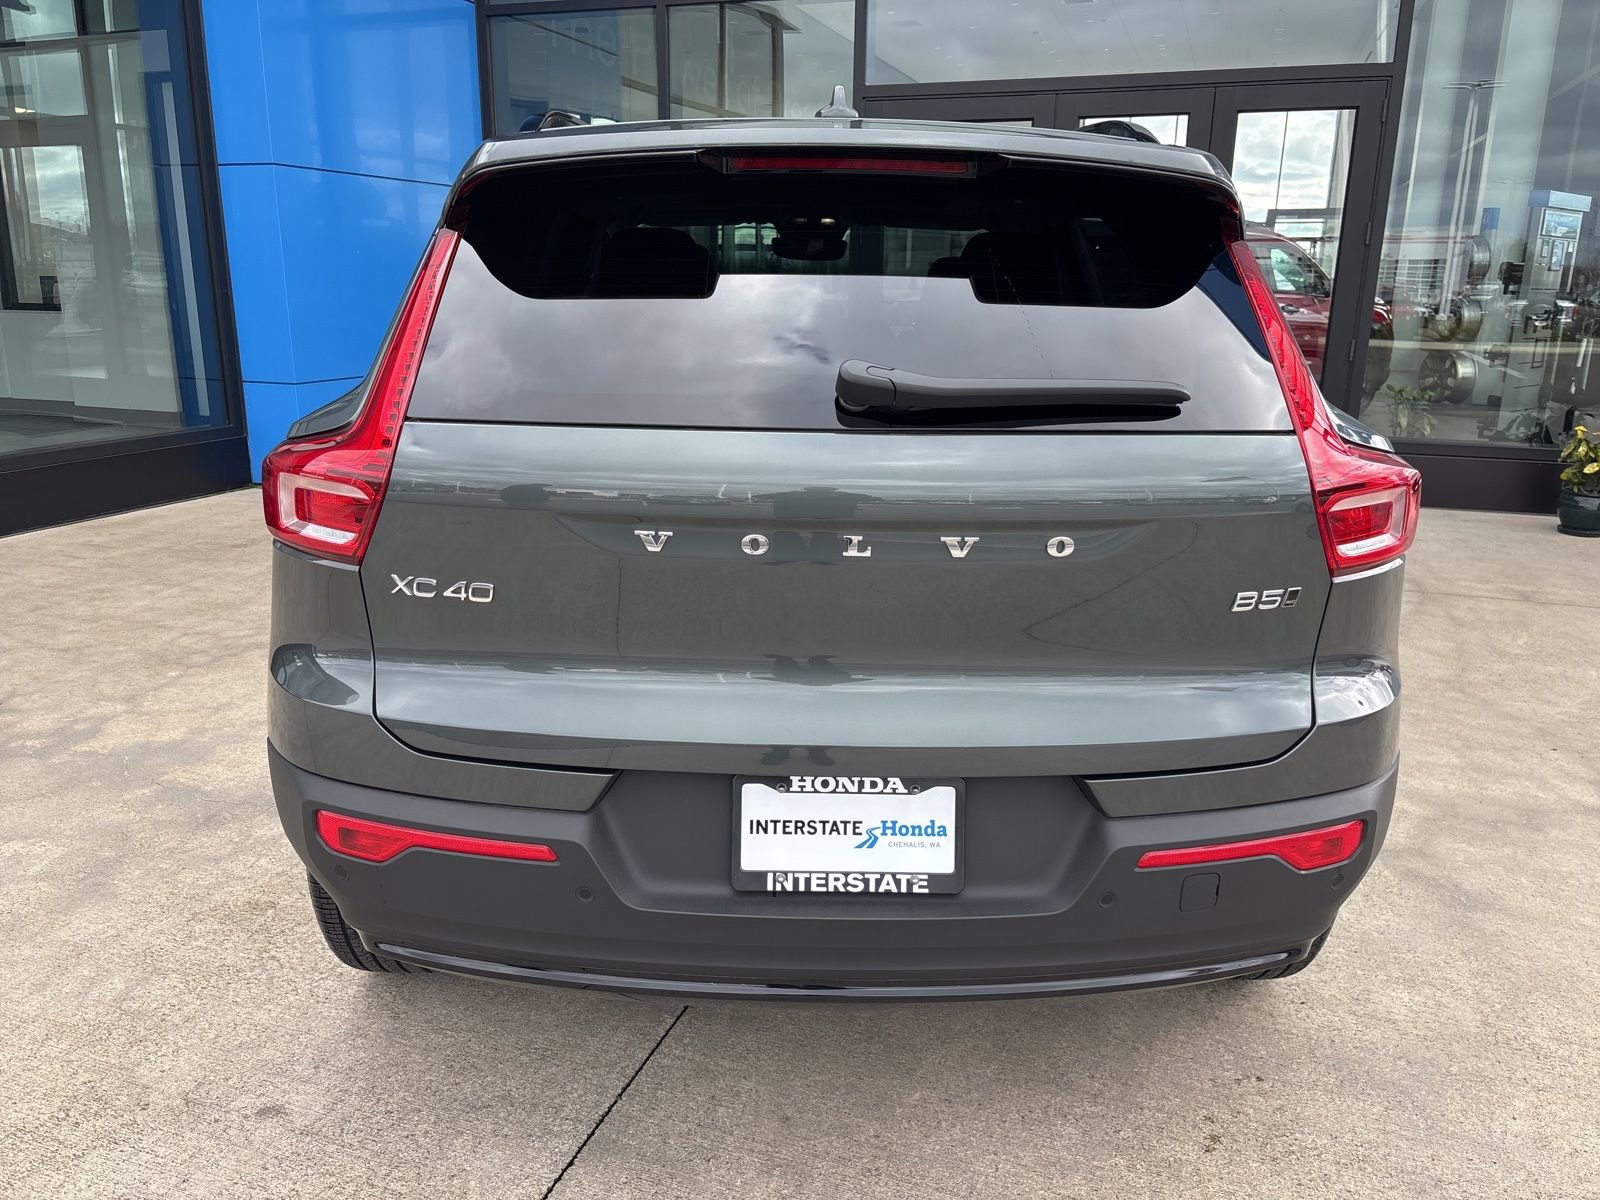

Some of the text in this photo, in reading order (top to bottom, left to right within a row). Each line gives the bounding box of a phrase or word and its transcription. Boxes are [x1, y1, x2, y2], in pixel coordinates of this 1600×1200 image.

[634, 529, 1075, 559] VOLVO
[789, 776, 908, 794] HONDA
[749, 819, 948, 838] INTERSTATE Honda
[888, 840, 941, 849] CHEHALIS, WA
[766, 872, 930, 894] INTERSTATE
